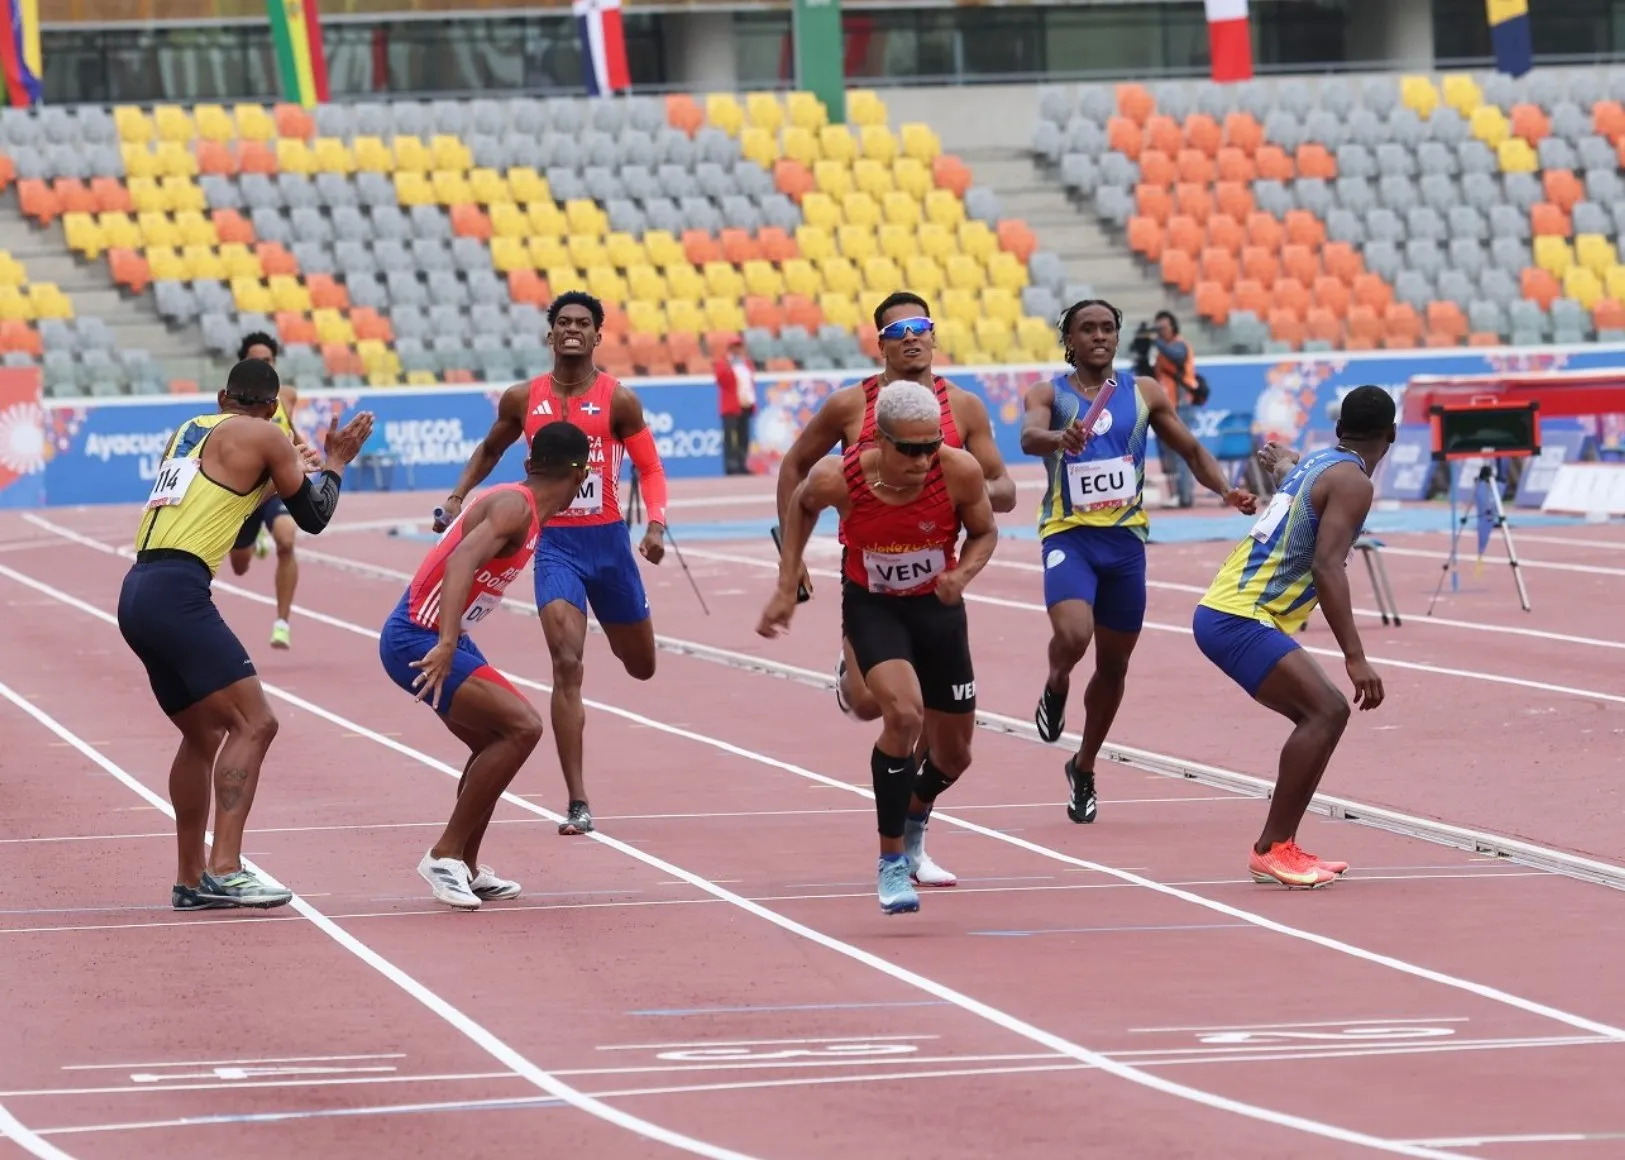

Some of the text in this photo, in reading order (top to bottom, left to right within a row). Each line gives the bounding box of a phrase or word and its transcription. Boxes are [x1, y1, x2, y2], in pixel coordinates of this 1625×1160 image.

[154, 468, 180, 493] 114
[1081, 471, 1124, 495] ECU
[876, 558, 932, 582] VEN
[466, 605, 492, 623] DO
